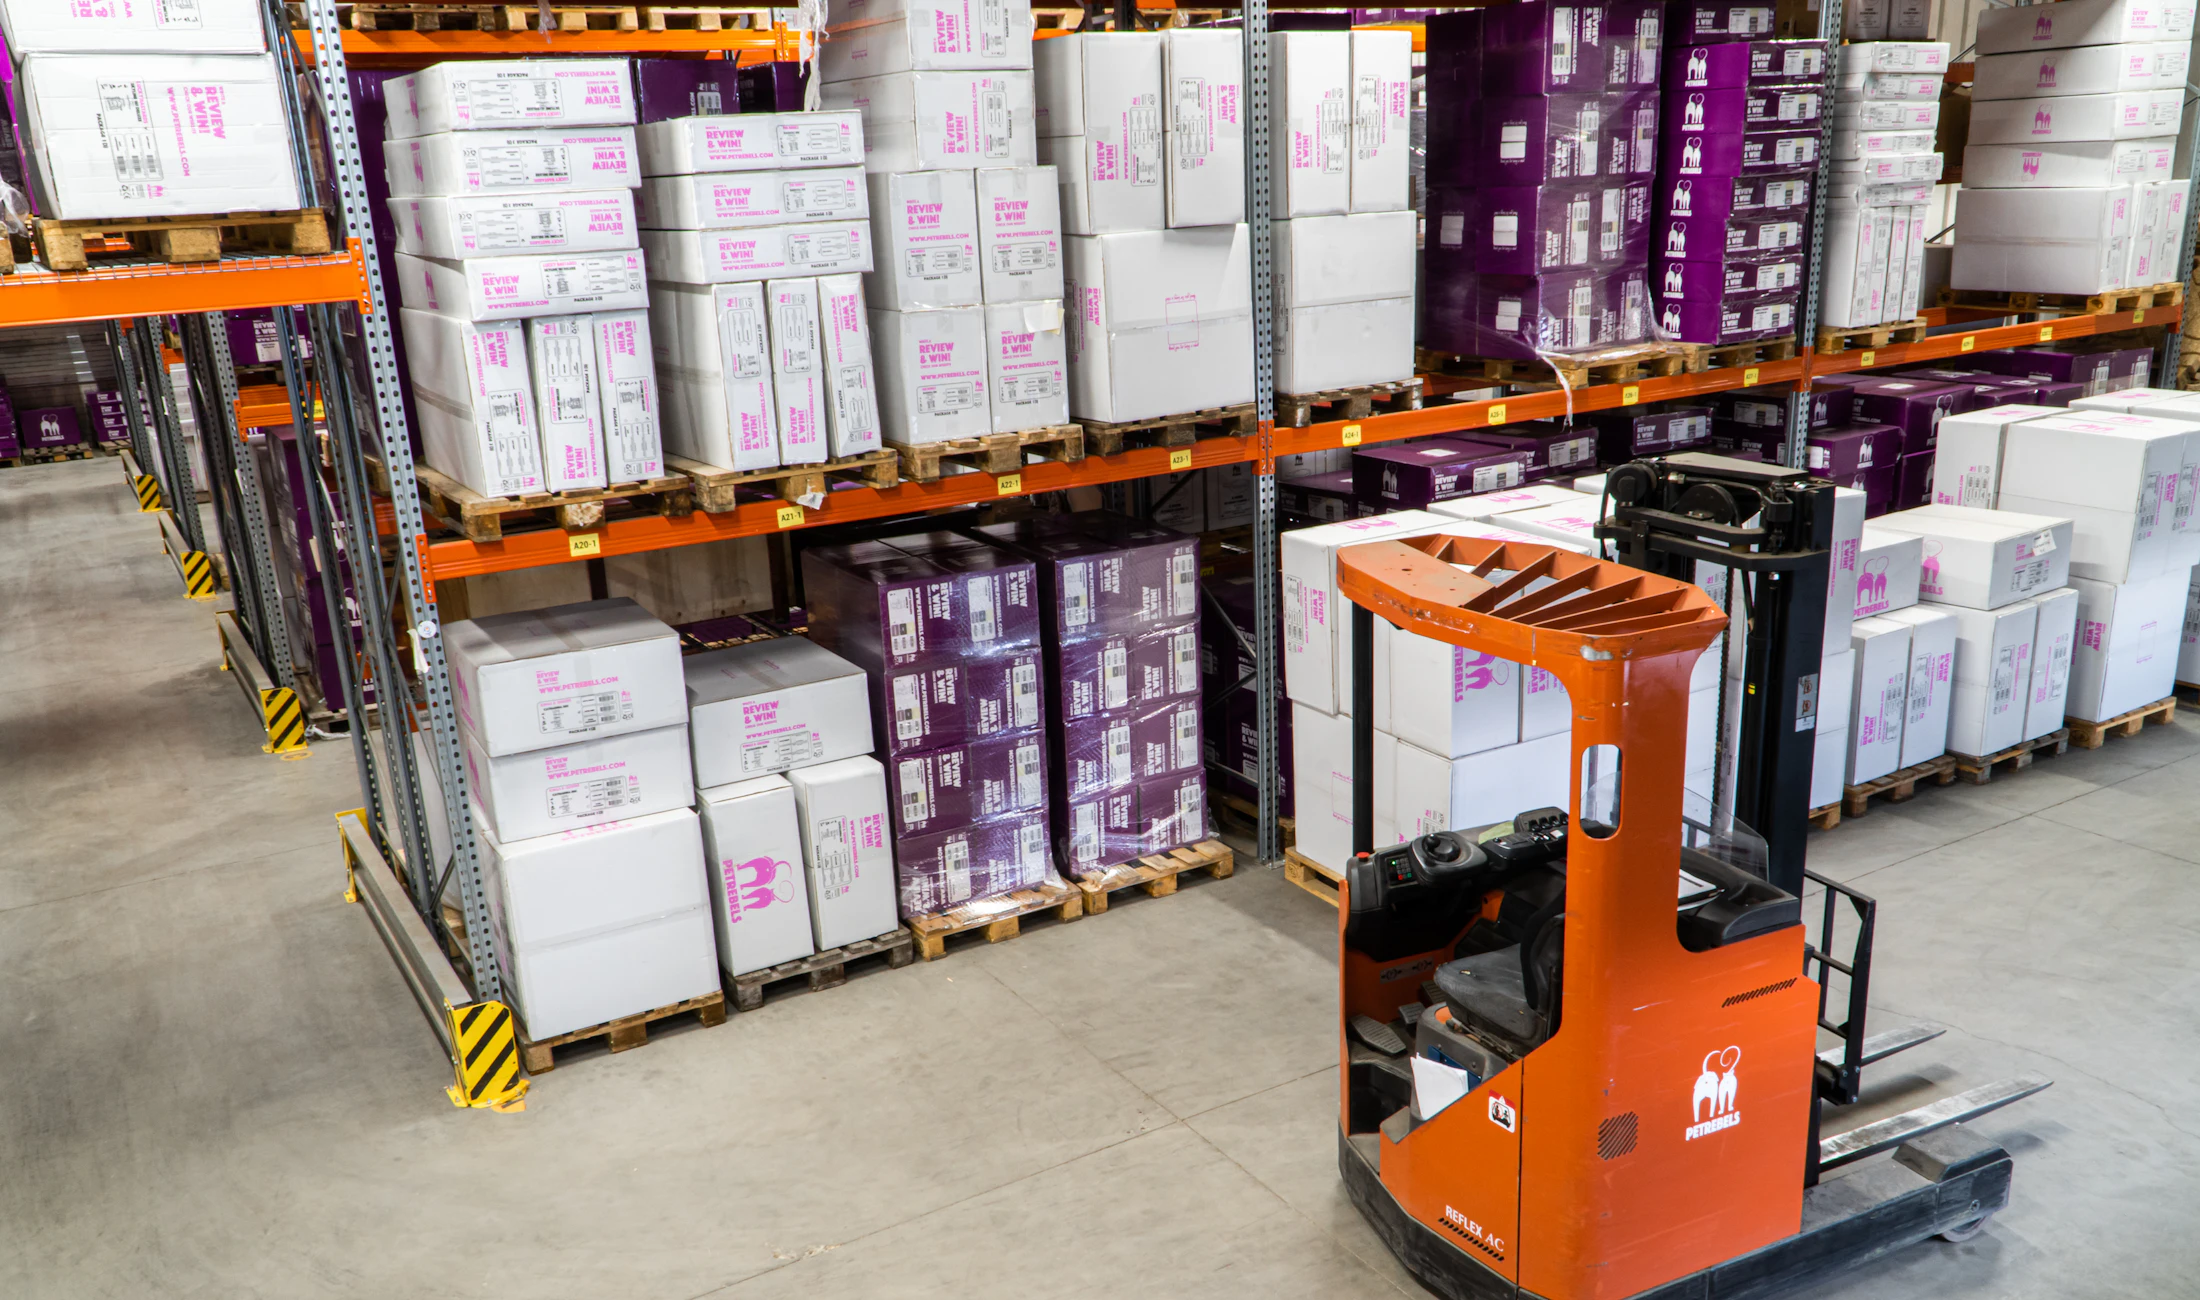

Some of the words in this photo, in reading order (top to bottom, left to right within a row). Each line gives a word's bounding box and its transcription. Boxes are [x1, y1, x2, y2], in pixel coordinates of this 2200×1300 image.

[936, 10, 946, 53] REVIEW
[946, 16, 954, 41] WIN!
[190, 87, 202, 96] &
[585, 95, 620, 104] REVIEW
[588, 86, 610, 94] WIN!
[204, 86, 225, 138] REVIEW
[1228, 85, 1237, 124] REVIEW
[194, 101, 210, 133] WIN!
[167, 87, 190, 177] WWW.PETREBELS.COM
[706, 129, 744, 139] REVIEW
[945, 112, 956, 153] REVIEW
[956, 116, 964, 141] WIN!
[592, 160, 626, 170] REVIEW
[594, 152, 616, 160] WIN!
[709, 152, 774, 160] WWW.PETREBELS.COM
[1097, 141, 1105, 180] REVIEW
[1106, 145, 1114, 170] WIN!
[714, 188, 751, 197] REVIEW
[716, 210, 780, 218] WWW.PETREBELS.COM
[906, 204, 942, 214] REVIEW
[994, 201, 1028, 211] REVIEW
[591, 214, 612, 222] WIN!
[917, 214, 939, 224] WIN!
[1004, 212, 1024, 220] WIN!
[588, 222, 623, 232] REVIEW
[996, 230, 1053, 238] WWW.PETREBELS.COM
[719, 239, 756, 250] REVIEW
[909, 234, 969, 242] WWW.PETREBELS.COM
[730, 250, 752, 258] WIN!
[722, 262, 784, 271] WWW.PETREBELS.COM
[482, 276, 519, 286] REVIEW
[494, 286, 516, 294] WIN!
[842, 306, 851, 329] WIN!
[847, 294, 858, 332] REVIEW
[617, 331, 626, 352] WIN!
[624, 321, 636, 356] REVIEW
[1001, 331, 1034, 344] REVIEW
[488, 342, 498, 364] WIN!
[495, 331, 508, 368] REVIEW
[919, 342, 954, 354] REVIEW
[929, 353, 950, 362] WIN!
[1011, 344, 1031, 352] WIN!
[920, 370, 980, 380] WWW.PETREBELS.COM
[1002, 360, 1059, 371] WWW.PETREBELS.COM
[740, 412, 752, 450] REVIEW
[749, 416, 758, 438] WIN!
[788, 406, 799, 444] REVIEW
[566, 445, 578, 479] REVIEW
[575, 448, 583, 469] WIN!
[1172, 455, 1188, 464] A23-1
[1000, 480, 1018, 489] A22-1
[1435, 474, 1458, 484] REVIEW
[1440, 482, 1455, 490] WIN!
[781, 512, 802, 522] A21-1
[574, 540, 596, 549] A20-1
[1103, 559, 1112, 567] &
[1848, 538, 1857, 571] REVIEW
[1009, 572, 1017, 580] &
[931, 584, 939, 592] &
[1011, 581, 1019, 604] WIN!
[1018, 570, 1027, 607] REVIEW
[932, 593, 941, 617] WIN!
[940, 582, 952, 620] REVIEW
[1318, 590, 1326, 624] REVIEW
[1854, 599, 1889, 616] PETREBELS
[2084, 629, 2095, 648] WIN!
[2092, 622, 2104, 651] REVIEW
[1144, 666, 1153, 699] REVIEW
[1454, 645, 1464, 702] ETREBELS
[538, 675, 618, 694] WWW.PETREBELS.COM
[937, 679, 946, 702] WIN!
[945, 668, 955, 704] REVIEW
[1071, 680, 1083, 715] REVIEW
[743, 700, 778, 717] REVIEW
[744, 716, 751, 724] &
[754, 711, 776, 722] WIN!
[980, 699, 989, 734] REVIEW
[746, 724, 806, 739] WWW.PETREBELS.COM
[1146, 743, 1156, 776] REVIEW
[546, 760, 626, 780] WWW.PETREBELS.COM
[943, 762, 952, 786] WIN!
[951, 752, 961, 787] REVIEW
[1119, 795, 1128, 828] REVIEW
[871, 814, 882, 848] REVIEW
[722, 860, 743, 923] PETREBELS
[1686, 1110, 1740, 1141] PETREBELS
[1446, 1205, 1482, 1238] REFLEX
[1485, 1233, 1504, 1252] AC
